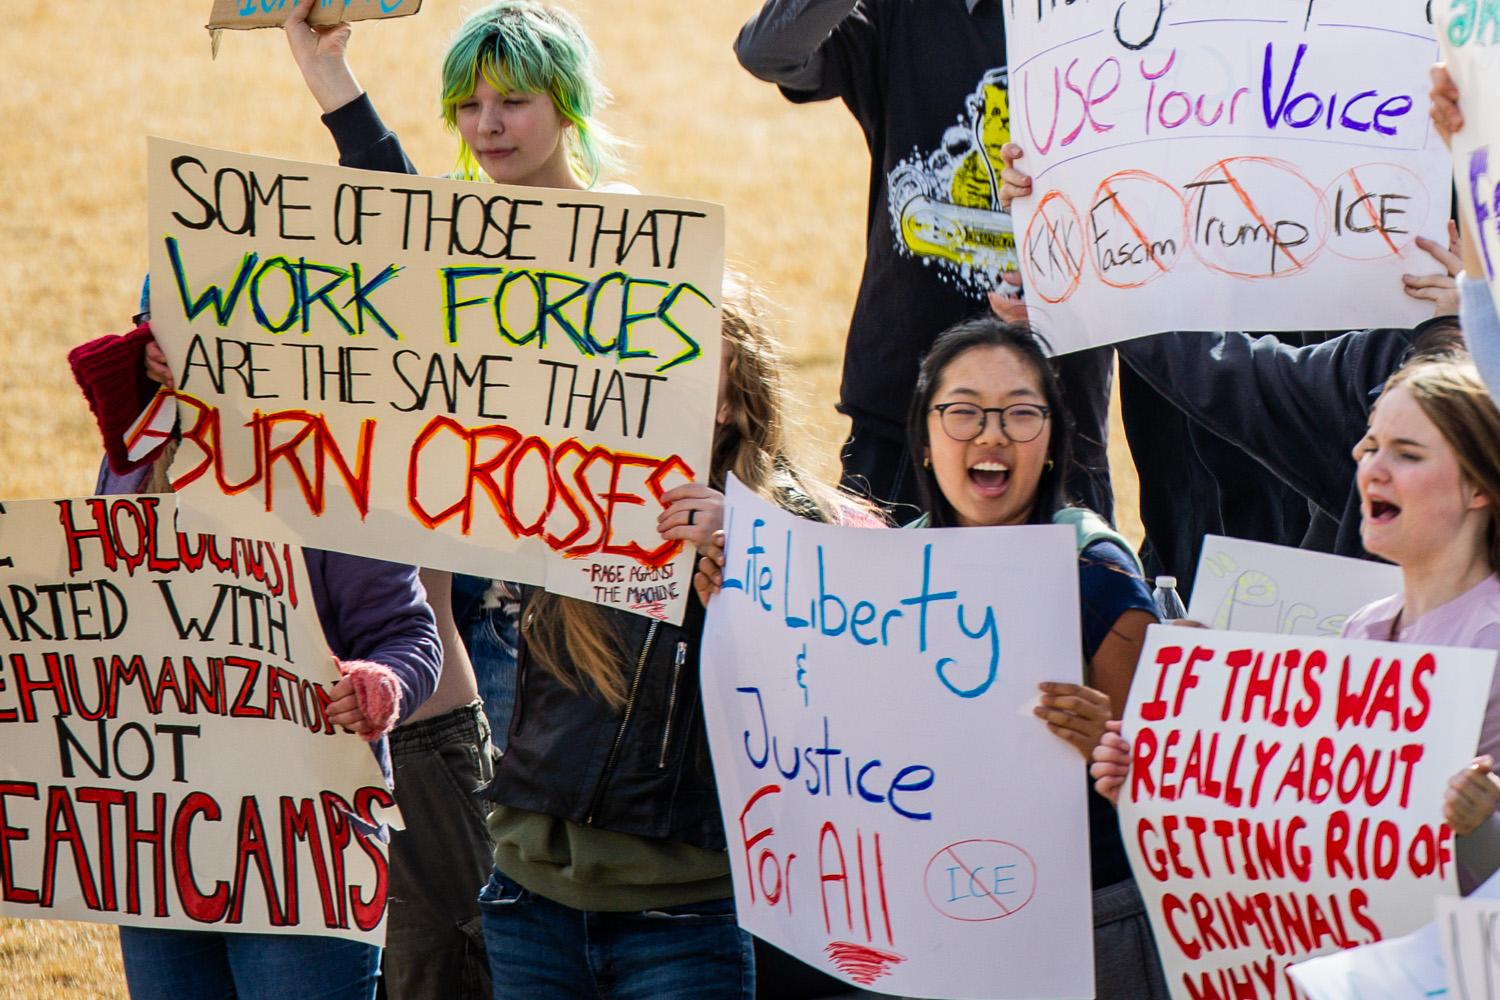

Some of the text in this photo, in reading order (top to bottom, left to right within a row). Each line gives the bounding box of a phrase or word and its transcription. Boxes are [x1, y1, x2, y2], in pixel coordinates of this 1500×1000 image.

[1140, 49, 1251, 136] Your
[1261, 42, 1413, 136] Voice
[171, 155, 706, 269] SOME OF THOSE THAT
[1028, 217, 1081, 281] KKK
[1183, 179, 1310, 275] Trump
[1333, 185, 1412, 236] ICE
[165, 235, 716, 373] WORK FORCES
[179, 334, 668, 440] ARE THE SAME THAT
[124, 387, 695, 569] BURN CROSSES
[593, 582, 680, 604] THE MACHINE
[629, 562, 675, 583] AGAINST
[784, 530, 999, 699] Liberty
[151, 579, 294, 664] WITH
[1138, 644, 1438, 735] IF THIS WAS
[55, 714, 201, 783] NOT
[736, 686, 935, 821] Justice
[1131, 728, 1425, 810] REALLY ABOUT
[740, 784, 895, 946] For All
[946, 861, 1017, 904] ICE
[1137, 811, 1312, 884] GETTING
[1326, 810, 1399, 881] RID
[1408, 821, 1451, 879] OF
[1160, 886, 1382, 961] CRIMINALS
